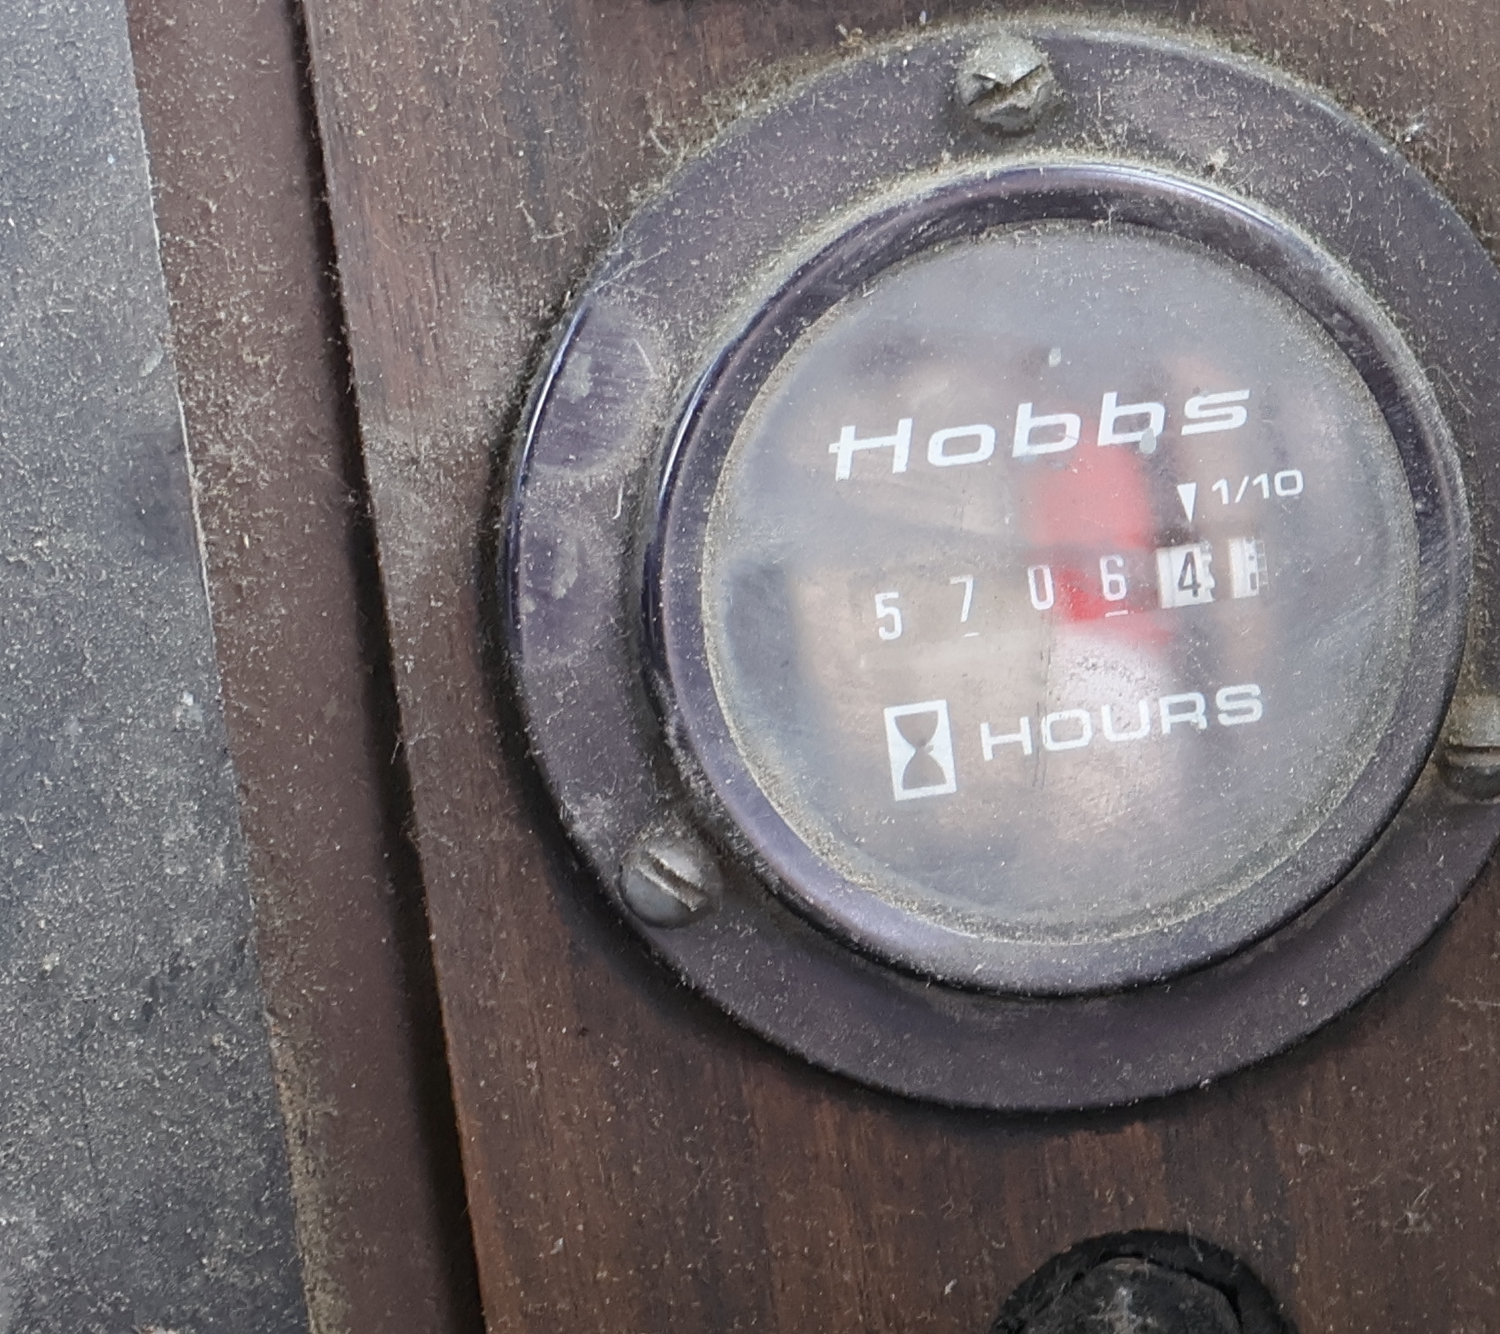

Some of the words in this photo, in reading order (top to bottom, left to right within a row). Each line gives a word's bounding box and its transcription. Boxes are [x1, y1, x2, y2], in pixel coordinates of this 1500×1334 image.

[828, 388, 1251, 481] Hobbs
[1210, 469, 1305, 505] 1/10
[979, 682, 1264, 760] HOURS
